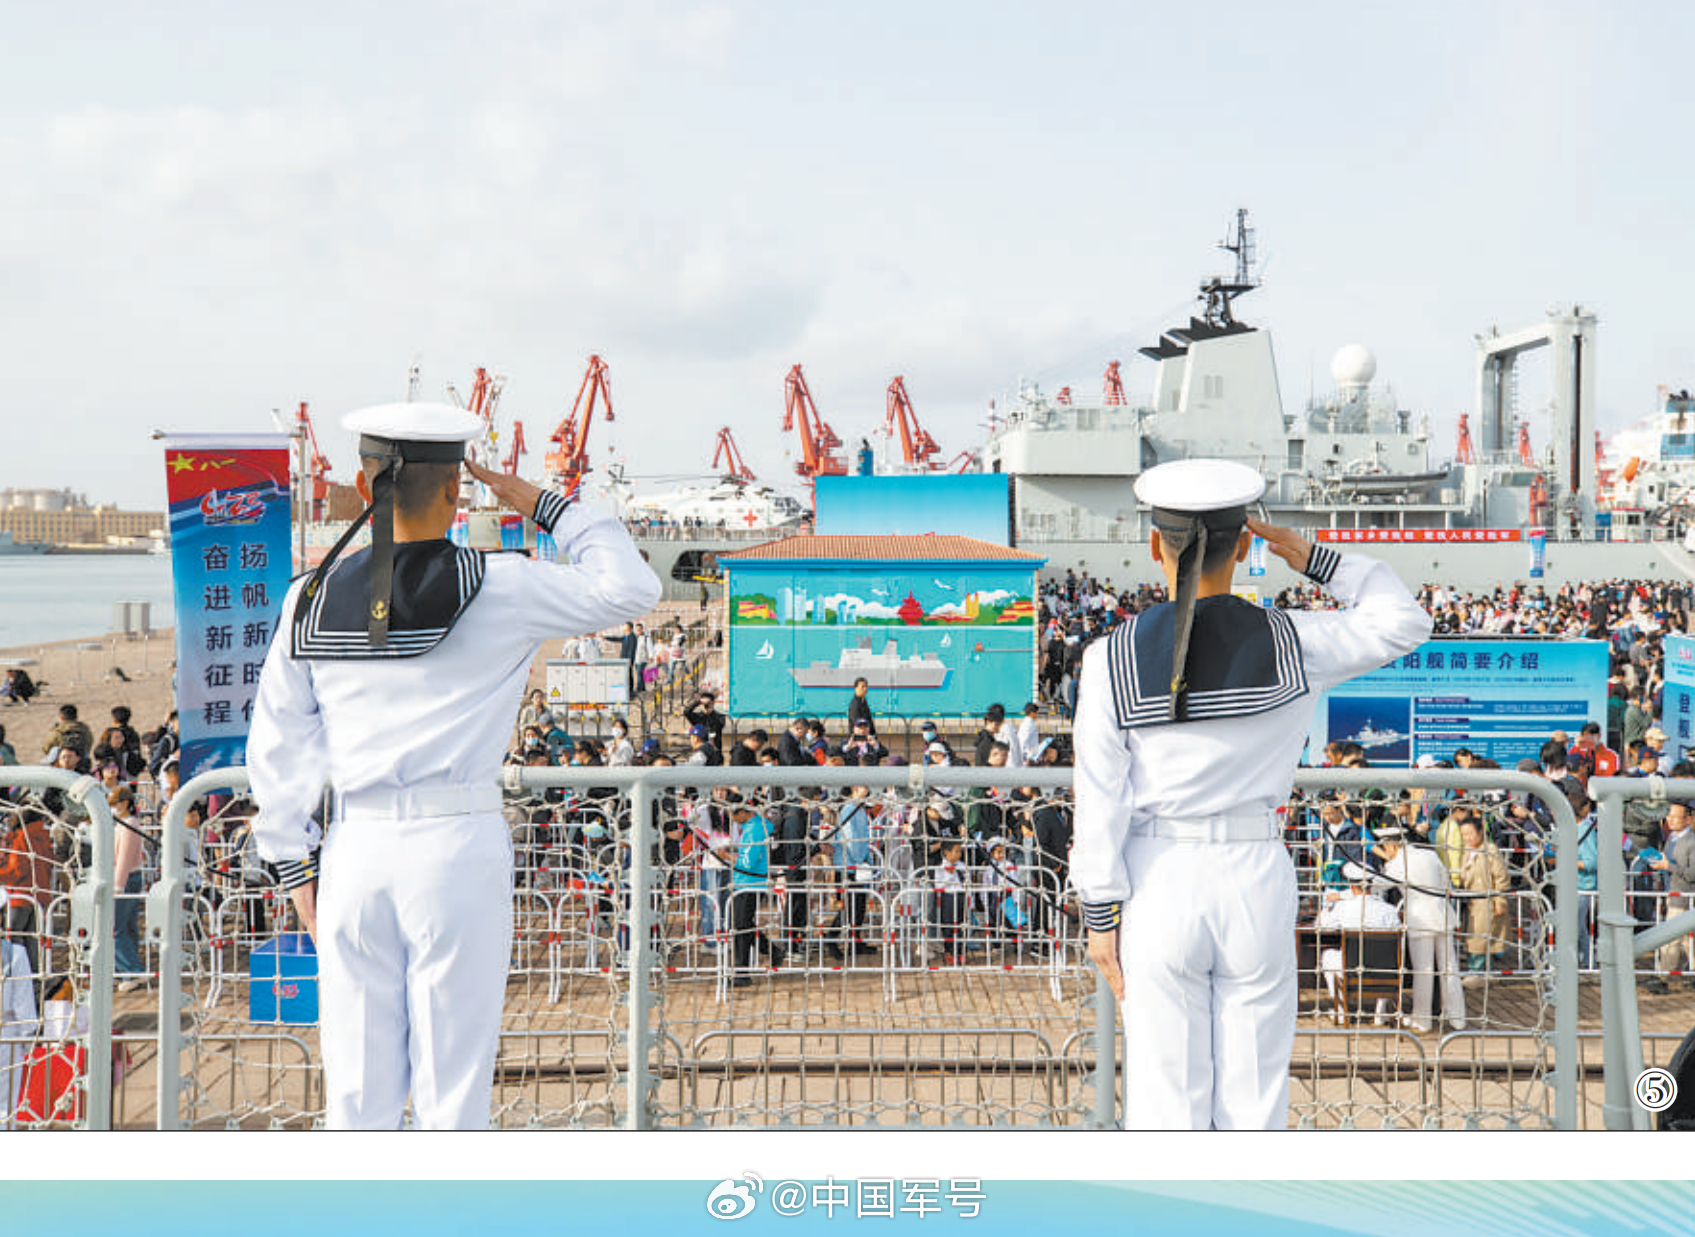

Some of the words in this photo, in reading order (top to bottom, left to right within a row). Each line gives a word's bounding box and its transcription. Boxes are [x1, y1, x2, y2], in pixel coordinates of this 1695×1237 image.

[203, 543, 234, 725] 奋进新征程
[1381, 652, 1539, 670] 阳舰简要介绍
